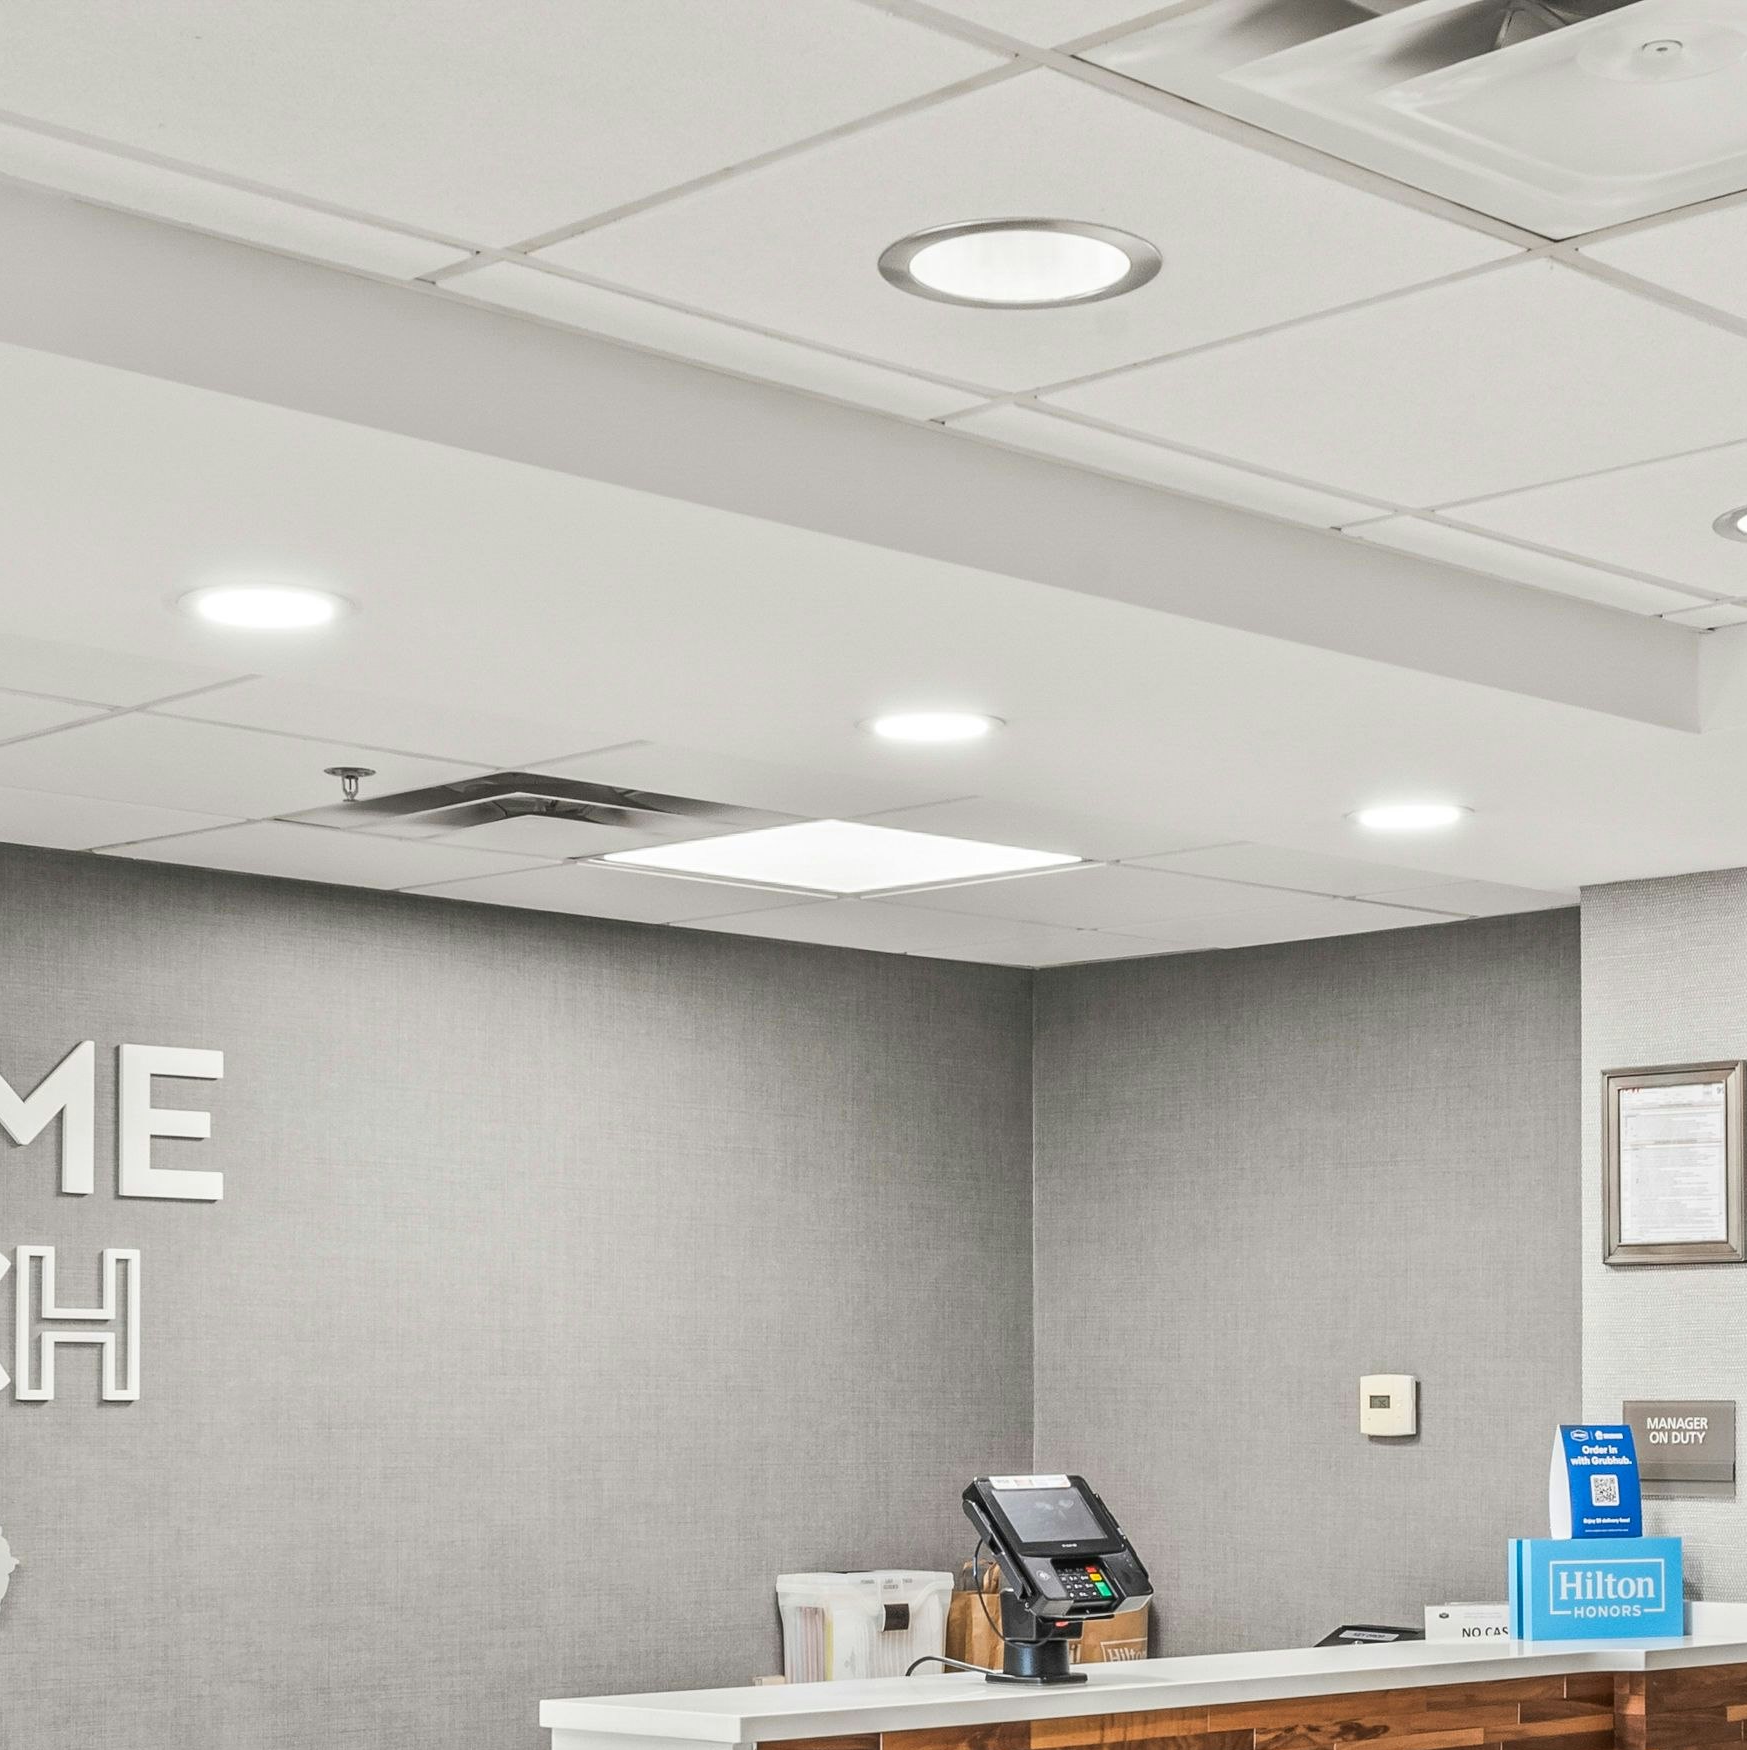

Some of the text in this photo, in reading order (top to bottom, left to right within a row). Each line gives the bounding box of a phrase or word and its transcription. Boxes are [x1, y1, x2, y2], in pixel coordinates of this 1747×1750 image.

[1646, 1416, 1708, 1430] MANAGER
[1649, 1431, 1706, 1444] ON DUTY
[1581, 1445, 1618, 1455] Order in
[1570, 1456, 1590, 1466] with
[1558, 1570, 1656, 1601] Hilton
[1574, 1604, 1642, 1619] HONORS
[1461, 1626, 1509, 1638] NO CAS
